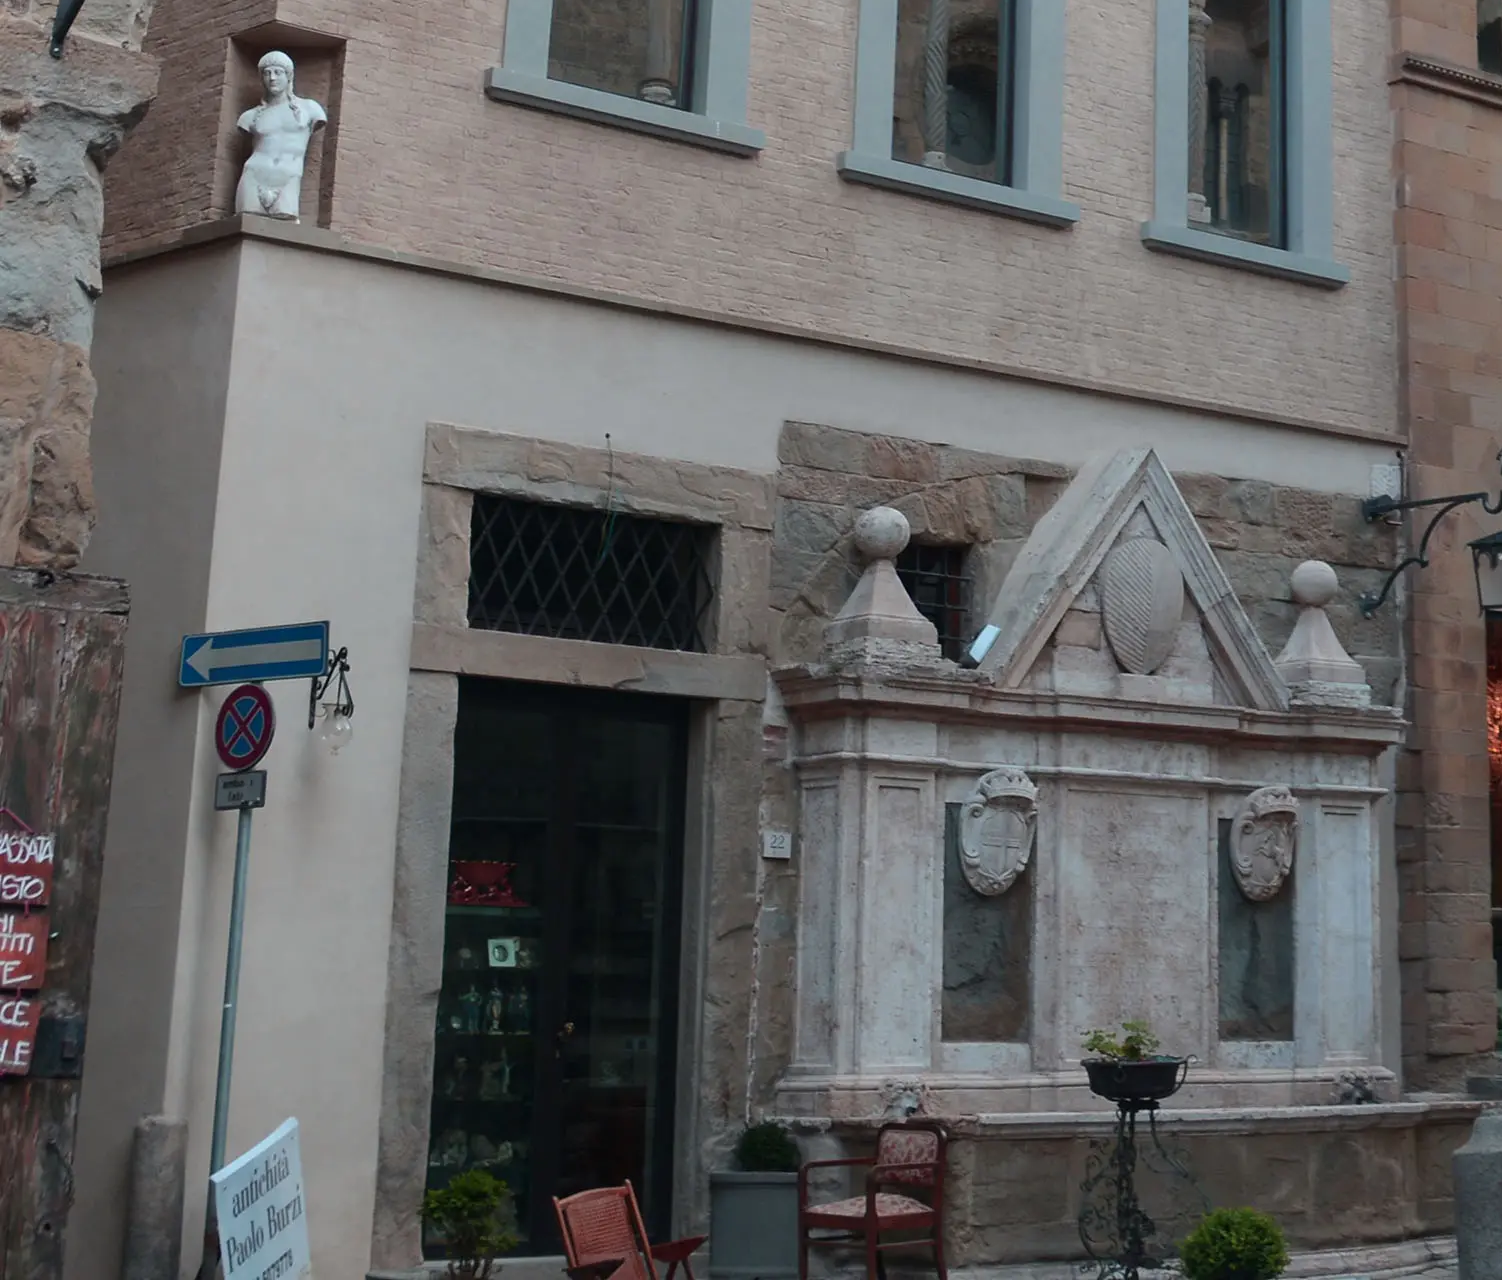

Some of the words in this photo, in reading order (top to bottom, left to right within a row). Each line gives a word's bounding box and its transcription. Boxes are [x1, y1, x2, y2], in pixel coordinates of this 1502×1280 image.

[0, 832, 55, 865] ASSATA
[770, 834, 785, 849] 22
[232, 1148, 290, 1218] antichità
[226, 1220, 264, 1273] Paolo
[266, 1183, 302, 1240] Burzi
